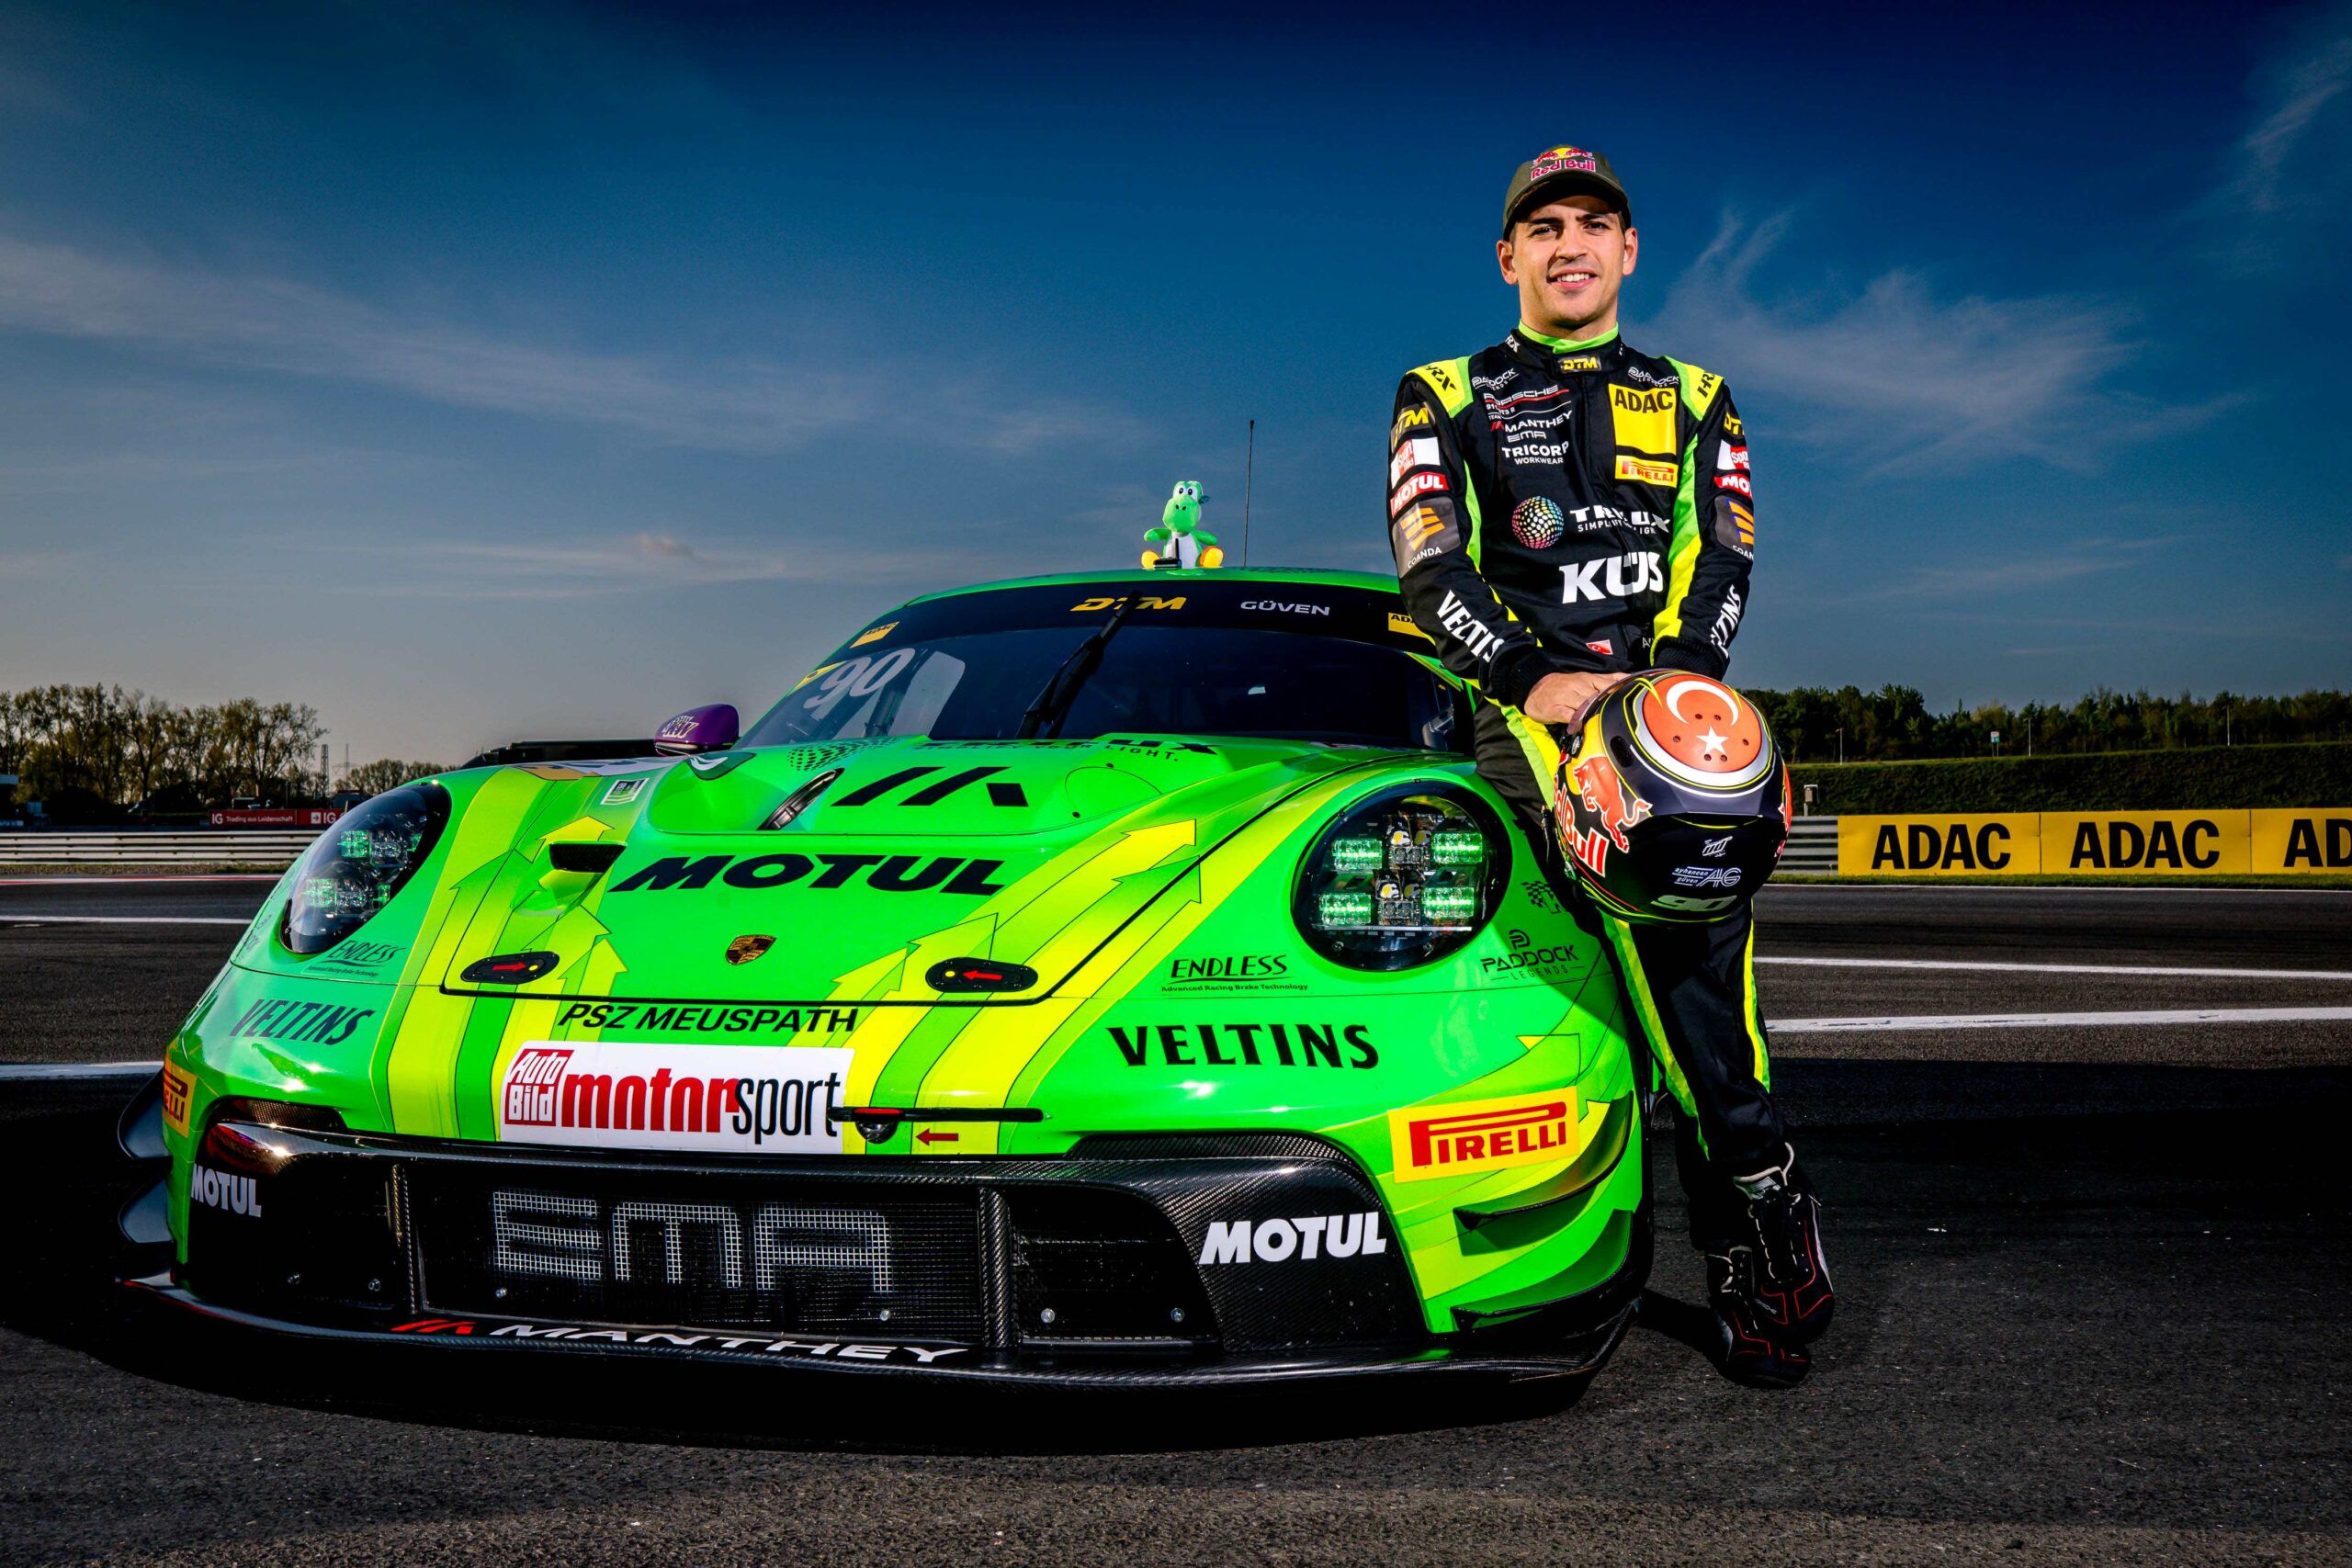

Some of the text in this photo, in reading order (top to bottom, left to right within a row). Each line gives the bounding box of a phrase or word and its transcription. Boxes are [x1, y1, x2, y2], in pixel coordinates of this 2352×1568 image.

[1531, 159, 1596, 181] Red Bull
[1563, 357, 1599, 370] DTM
[1471, 368, 1516, 388] PADOCK
[1615, 389, 1673, 413] ADAC
[1505, 410, 1573, 433] MANTHEY
[1724, 412, 1745, 435] DT
[1507, 430, 1547, 443] EMA
[1501, 441, 1569, 458] TRICORP
[1622, 460, 1674, 482] PIRELLI
[1394, 475, 1443, 513] MOTUL
[1408, 547, 1442, 569] COANDA
[1240, 601, 1329, 615] GÜVEN
[803, 648, 915, 708] 90
[1104, 745, 1179, 761] LIGHT.
[212, 813, 223, 824] IG
[258, 815, 293, 823] Leidenschaft
[323, 812, 336, 824] IG
[1563, 795, 1610, 878] Bull
[1871, 823, 2011, 870] ADAC
[2070, 819, 2220, 869] ADAC
[2283, 818, 2352, 868] AD
[607, 853, 1005, 896] MOTUL
[1651, 895, 1737, 912] 90
[327, 941, 406, 963] ENDLESS
[1480, 945, 1579, 973] PADDOCK
[1170, 955, 1287, 977] ENDLESS
[1510, 964, 1568, 980] LEGENDS
[1261, 983, 1308, 991] Technology
[230, 999, 375, 1045] VELTINS
[558, 1003, 859, 1033] PSZ MEUSPATH
[1106, 1024, 1379, 1068] VELTINS
[510, 1051, 568, 1084] Auto
[509, 1085, 554, 1122] Bild
[1409, 1101, 1566, 1168] PIRELLI
[190, 1163, 262, 1218] MOTUL
[493, 1190, 892, 1292] EMA
[1198, 1212, 1387, 1265] MOTUL
[489, 1325, 968, 1362] MANTHEY
